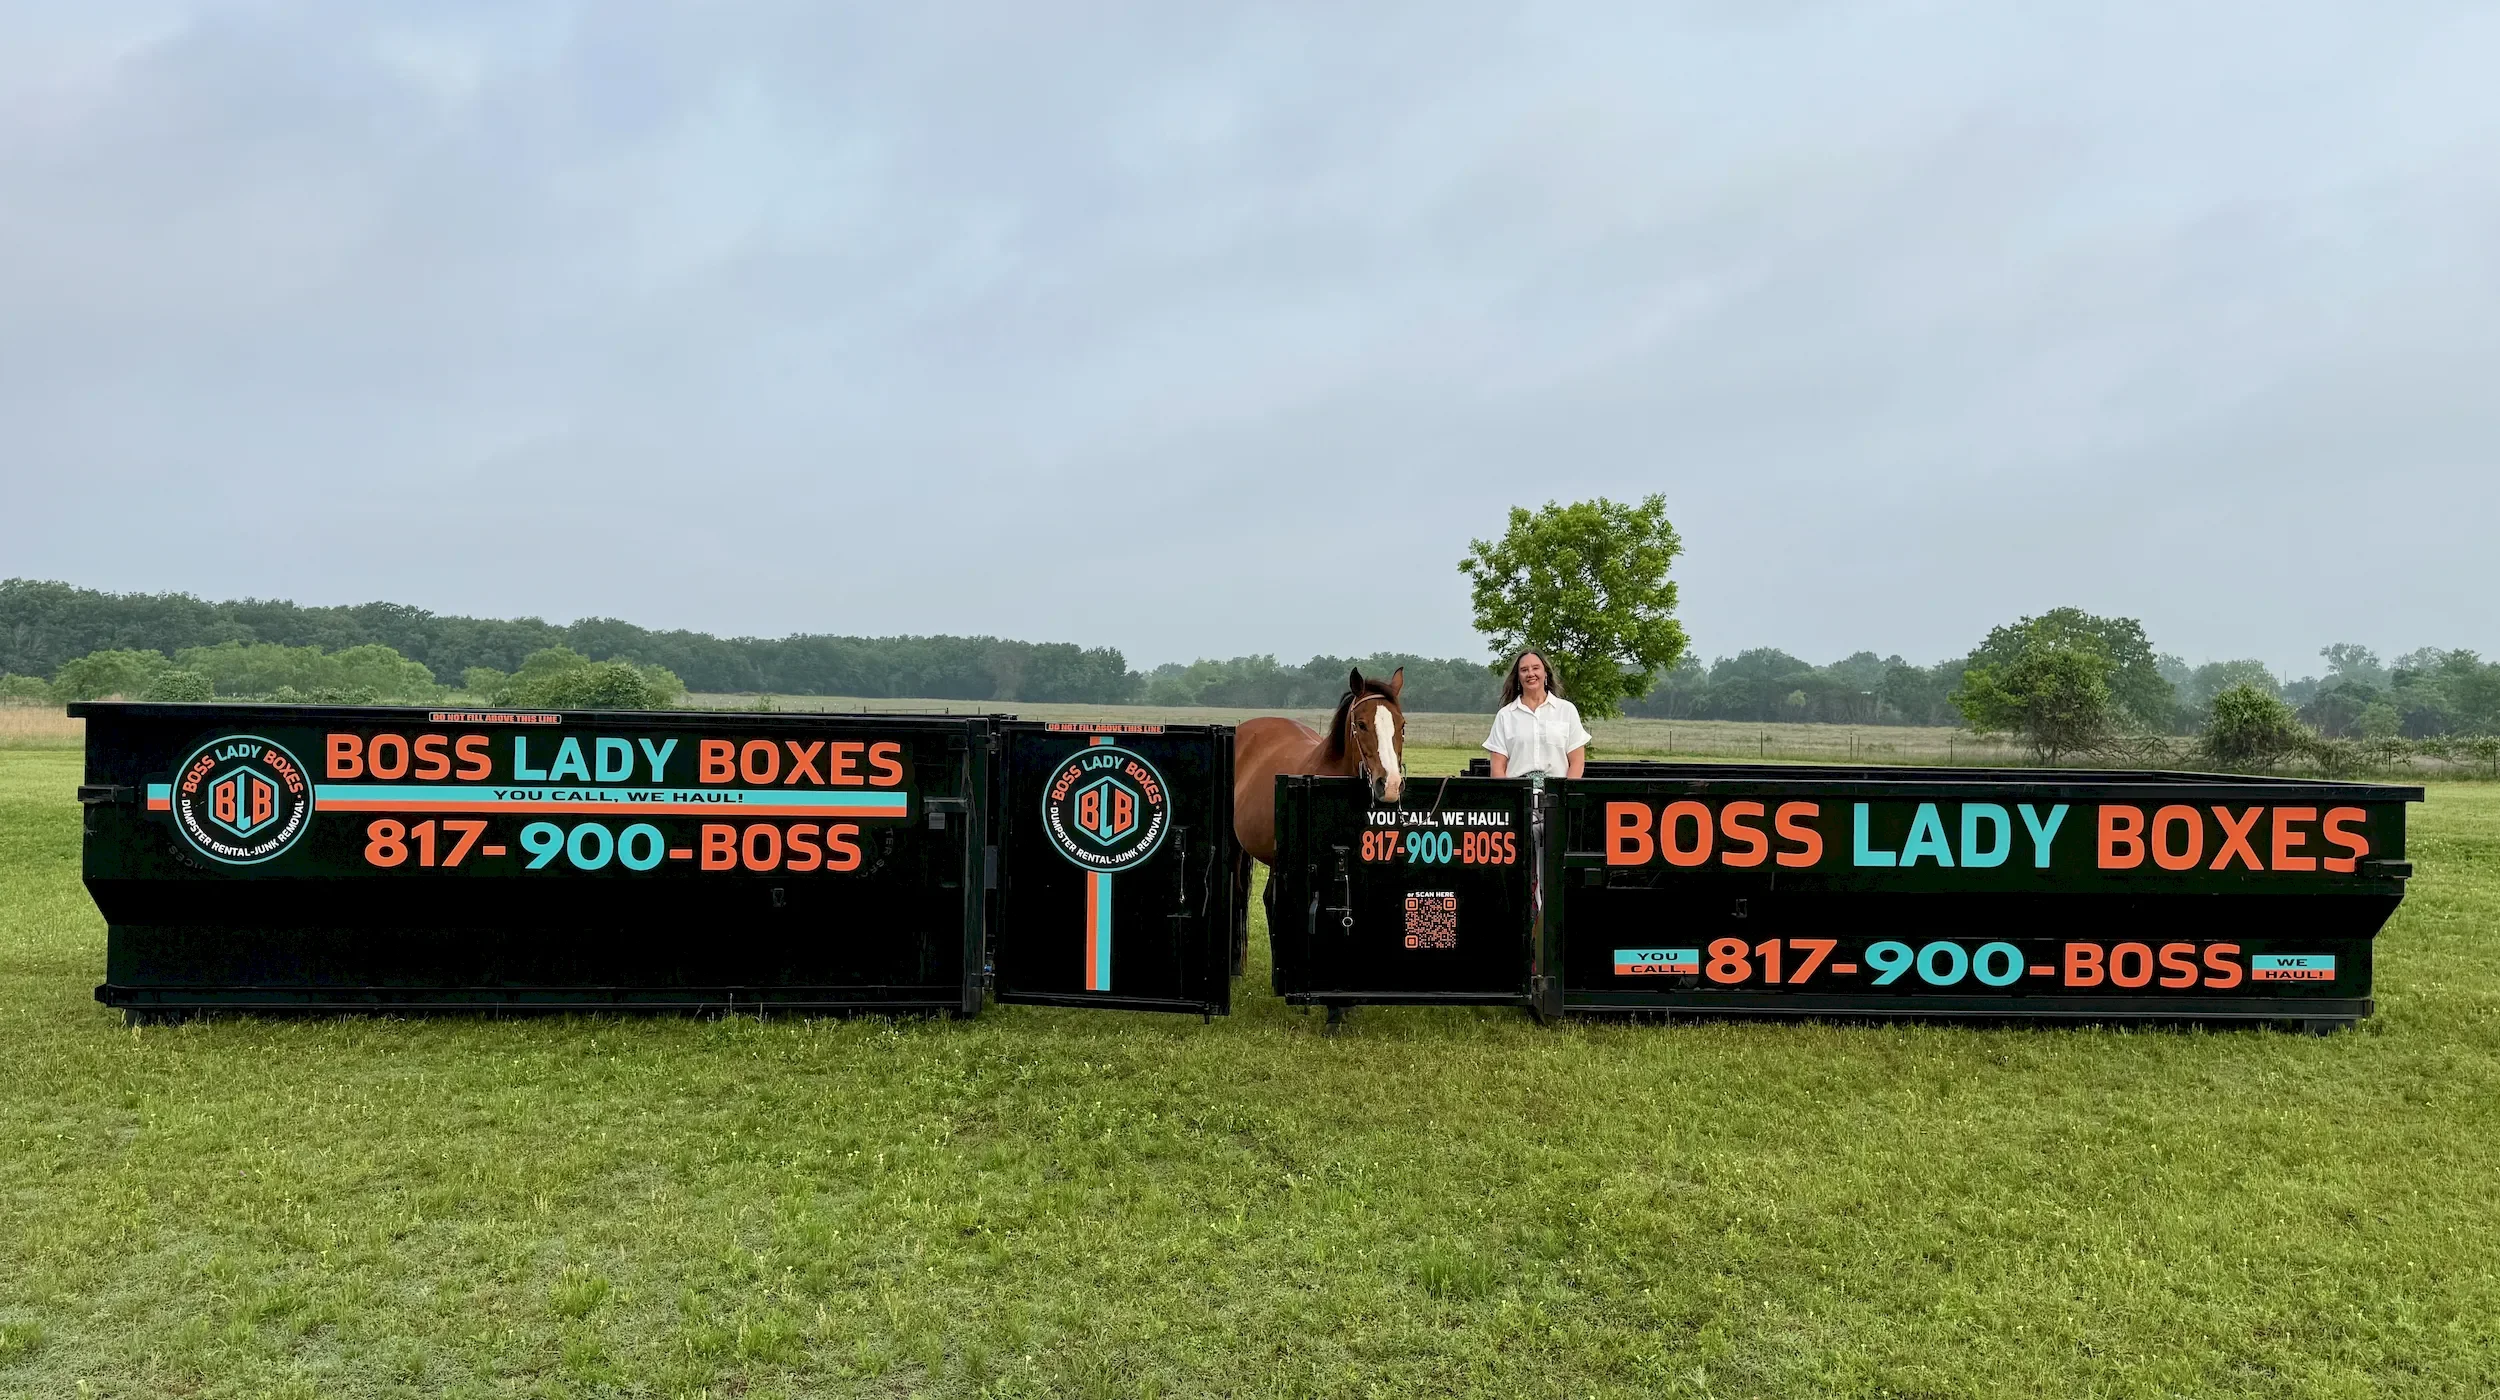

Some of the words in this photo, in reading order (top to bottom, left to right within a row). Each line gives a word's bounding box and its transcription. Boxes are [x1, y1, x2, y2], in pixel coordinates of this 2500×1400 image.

[485, 714, 515, 722] ABOVE
[516, 715, 536, 723] THIS
[539, 715, 557, 723] LINE
[183, 755, 215, 793] BOSS
[215, 744, 262, 761] LADY
[263, 750, 304, 793] BOXES
[327, 734, 492, 780] BOSS
[514, 736, 678, 782] LADY
[700, 740, 903, 786] BOXES
[1051, 764, 1082, 801] BOSS
[1081, 755, 1125, 772] LADY
[1125, 761, 1162, 804] BOXES
[215, 773, 271, 831] BLB
[493, 790, 543, 801] YOU
[551, 790, 619, 803] CALL,
[627, 791, 665, 802] WE
[673, 792, 744, 803] HAUL!
[1081, 783, 1132, 839] BLB
[1367, 812, 1396, 825] YOU
[1442, 812, 1464, 825] WE
[1468, 812, 1509, 825] HAUL!
[181, 799, 212, 846] DUMPSTER
[211, 839, 279, 857] RENTAL-JUNK
[277, 800, 304, 842] REMOVAL
[1050, 807, 1077, 853] DUMPSTER
[1076, 848, 1139, 865] RENTAL-JUNK
[1136, 811, 1162, 852] REMOVAL
[1362, 831, 1516, 864] 817-900-BOSS
[1606, 801, 1823, 867] BOSS
[1854, 803, 2069, 868] LADY
[2098, 805, 2369, 872] BOXES
[1631, 965, 1687, 974] CALL,
[1637, 952, 1678, 961] YOU
[1706, 938, 2242, 988] 817-900-BOSS
[2266, 971, 2323, 979] HAUL!
[2277, 958, 2308, 966] WE
